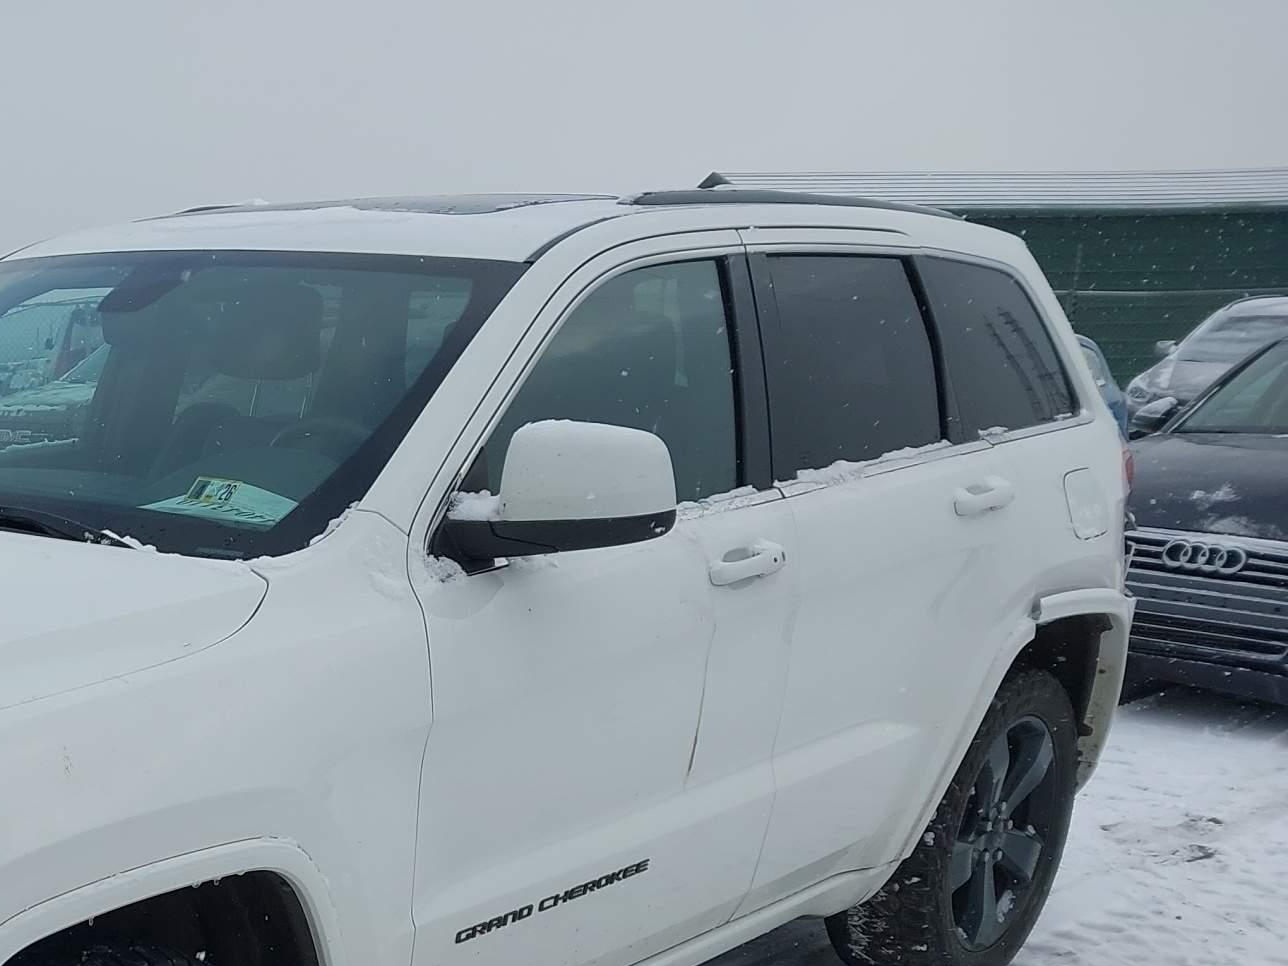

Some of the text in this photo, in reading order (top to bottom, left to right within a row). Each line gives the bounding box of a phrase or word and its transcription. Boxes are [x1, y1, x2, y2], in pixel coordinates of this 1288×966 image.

[217, 483, 238, 501] 26
[454, 858, 650, 944] GRAND CHEROKEE
